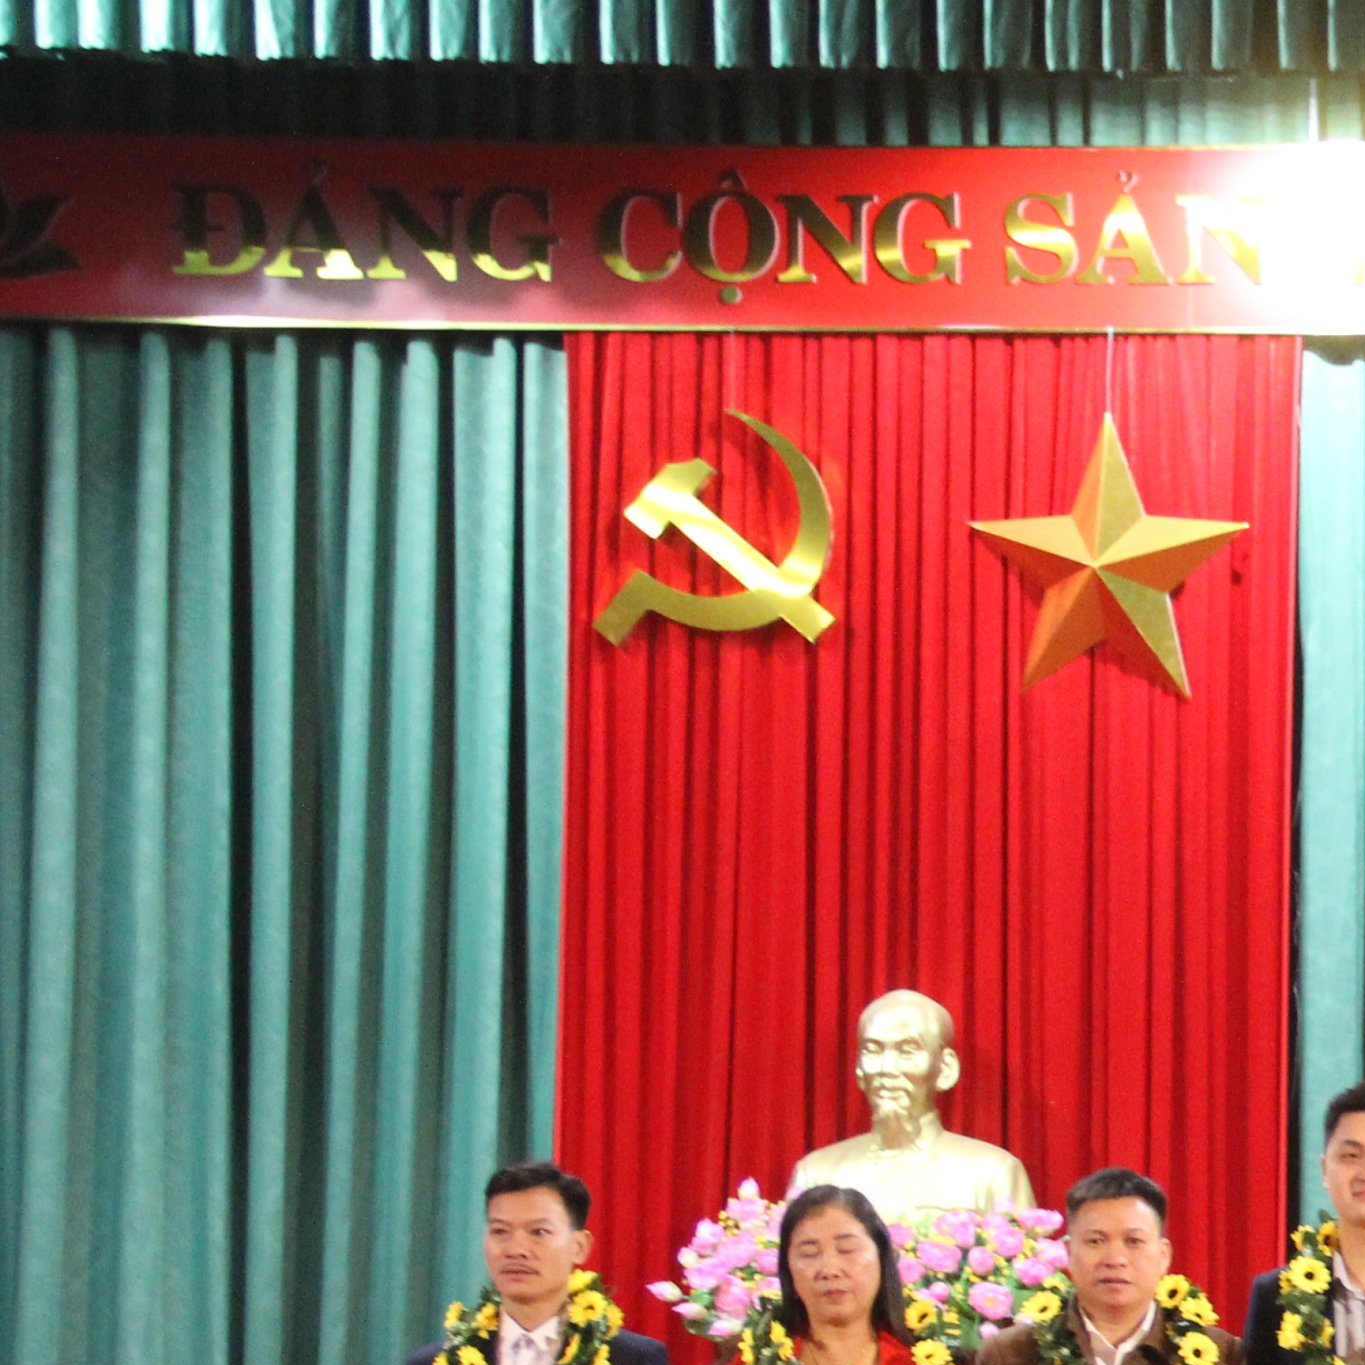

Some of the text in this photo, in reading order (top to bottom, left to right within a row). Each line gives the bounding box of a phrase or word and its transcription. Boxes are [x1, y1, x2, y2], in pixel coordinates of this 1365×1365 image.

[172, 158, 558, 283] ĐẢNG
[598, 168, 972, 304] CỘNG
[1003, 171, 1272, 285] SẢN
